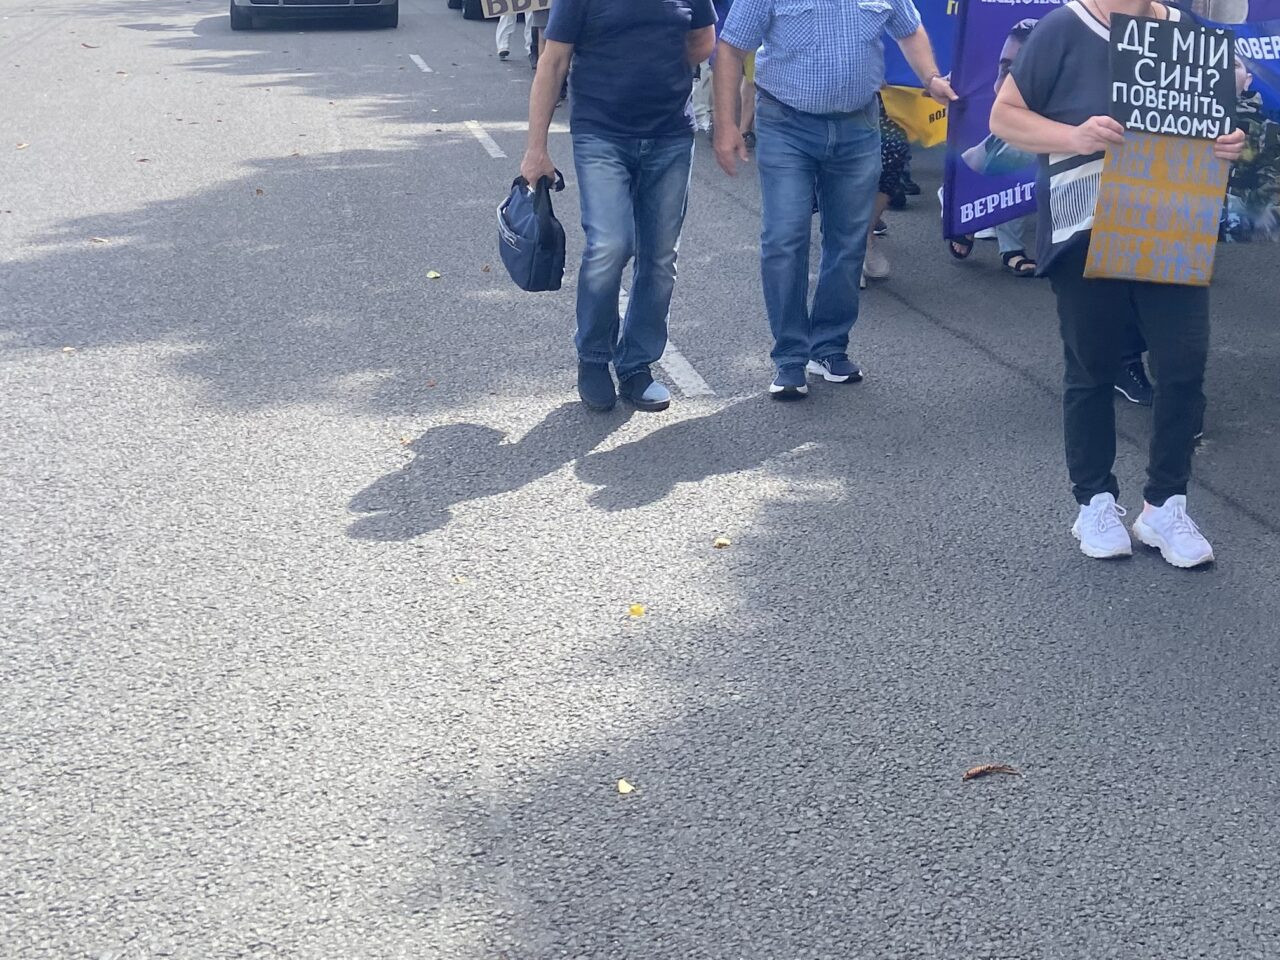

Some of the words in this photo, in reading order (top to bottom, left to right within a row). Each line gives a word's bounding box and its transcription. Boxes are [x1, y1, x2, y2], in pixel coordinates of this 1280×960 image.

[1117, 19, 1160, 58] ДЕ
[1134, 58, 1220, 96] СИН?
[1126, 108, 1231, 139] ДОДОМУ!
[960, 182, 1036, 223] ВЕРНІТ
